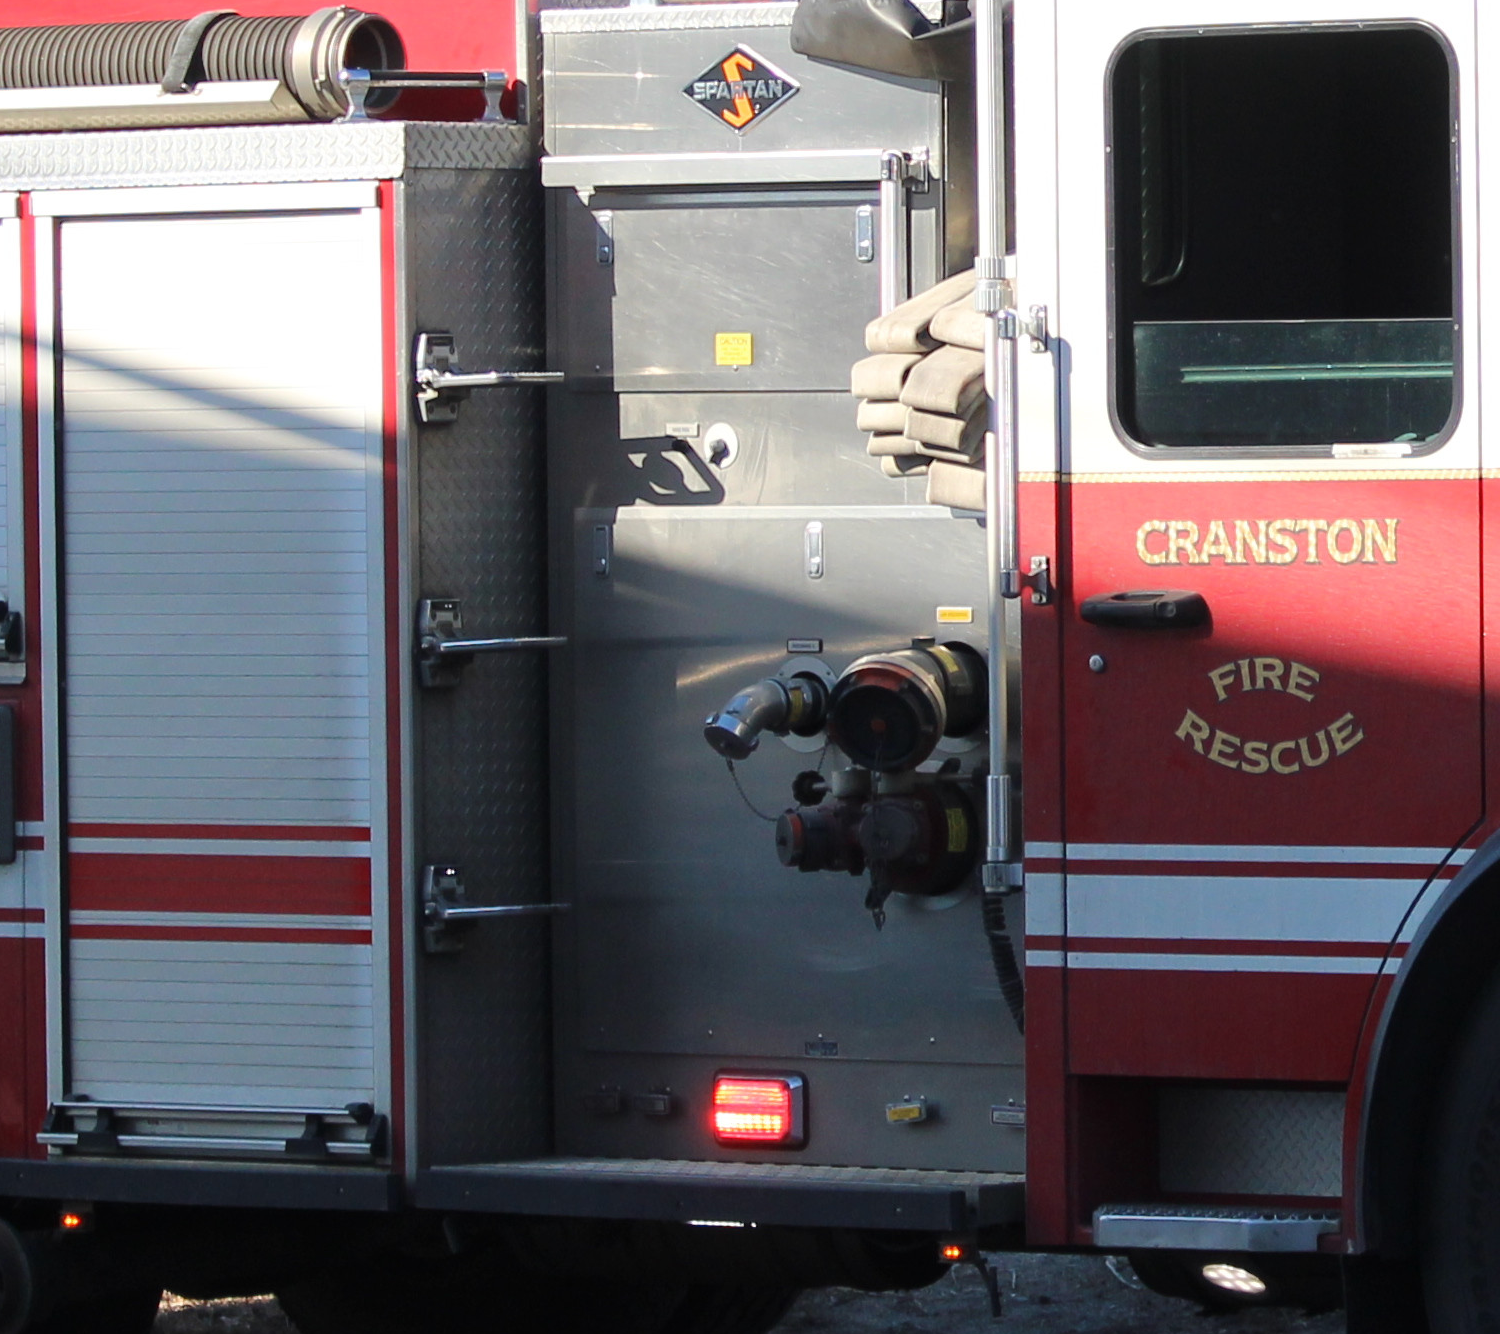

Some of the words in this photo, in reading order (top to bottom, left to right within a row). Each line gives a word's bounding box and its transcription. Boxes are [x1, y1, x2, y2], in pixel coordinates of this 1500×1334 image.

[693, 80, 783, 100] SPARTAN
[1135, 517, 1400, 565] CRANSTON
[1208, 656, 1321, 703] FIRE
[1174, 708, 1365, 775] RESCUE
